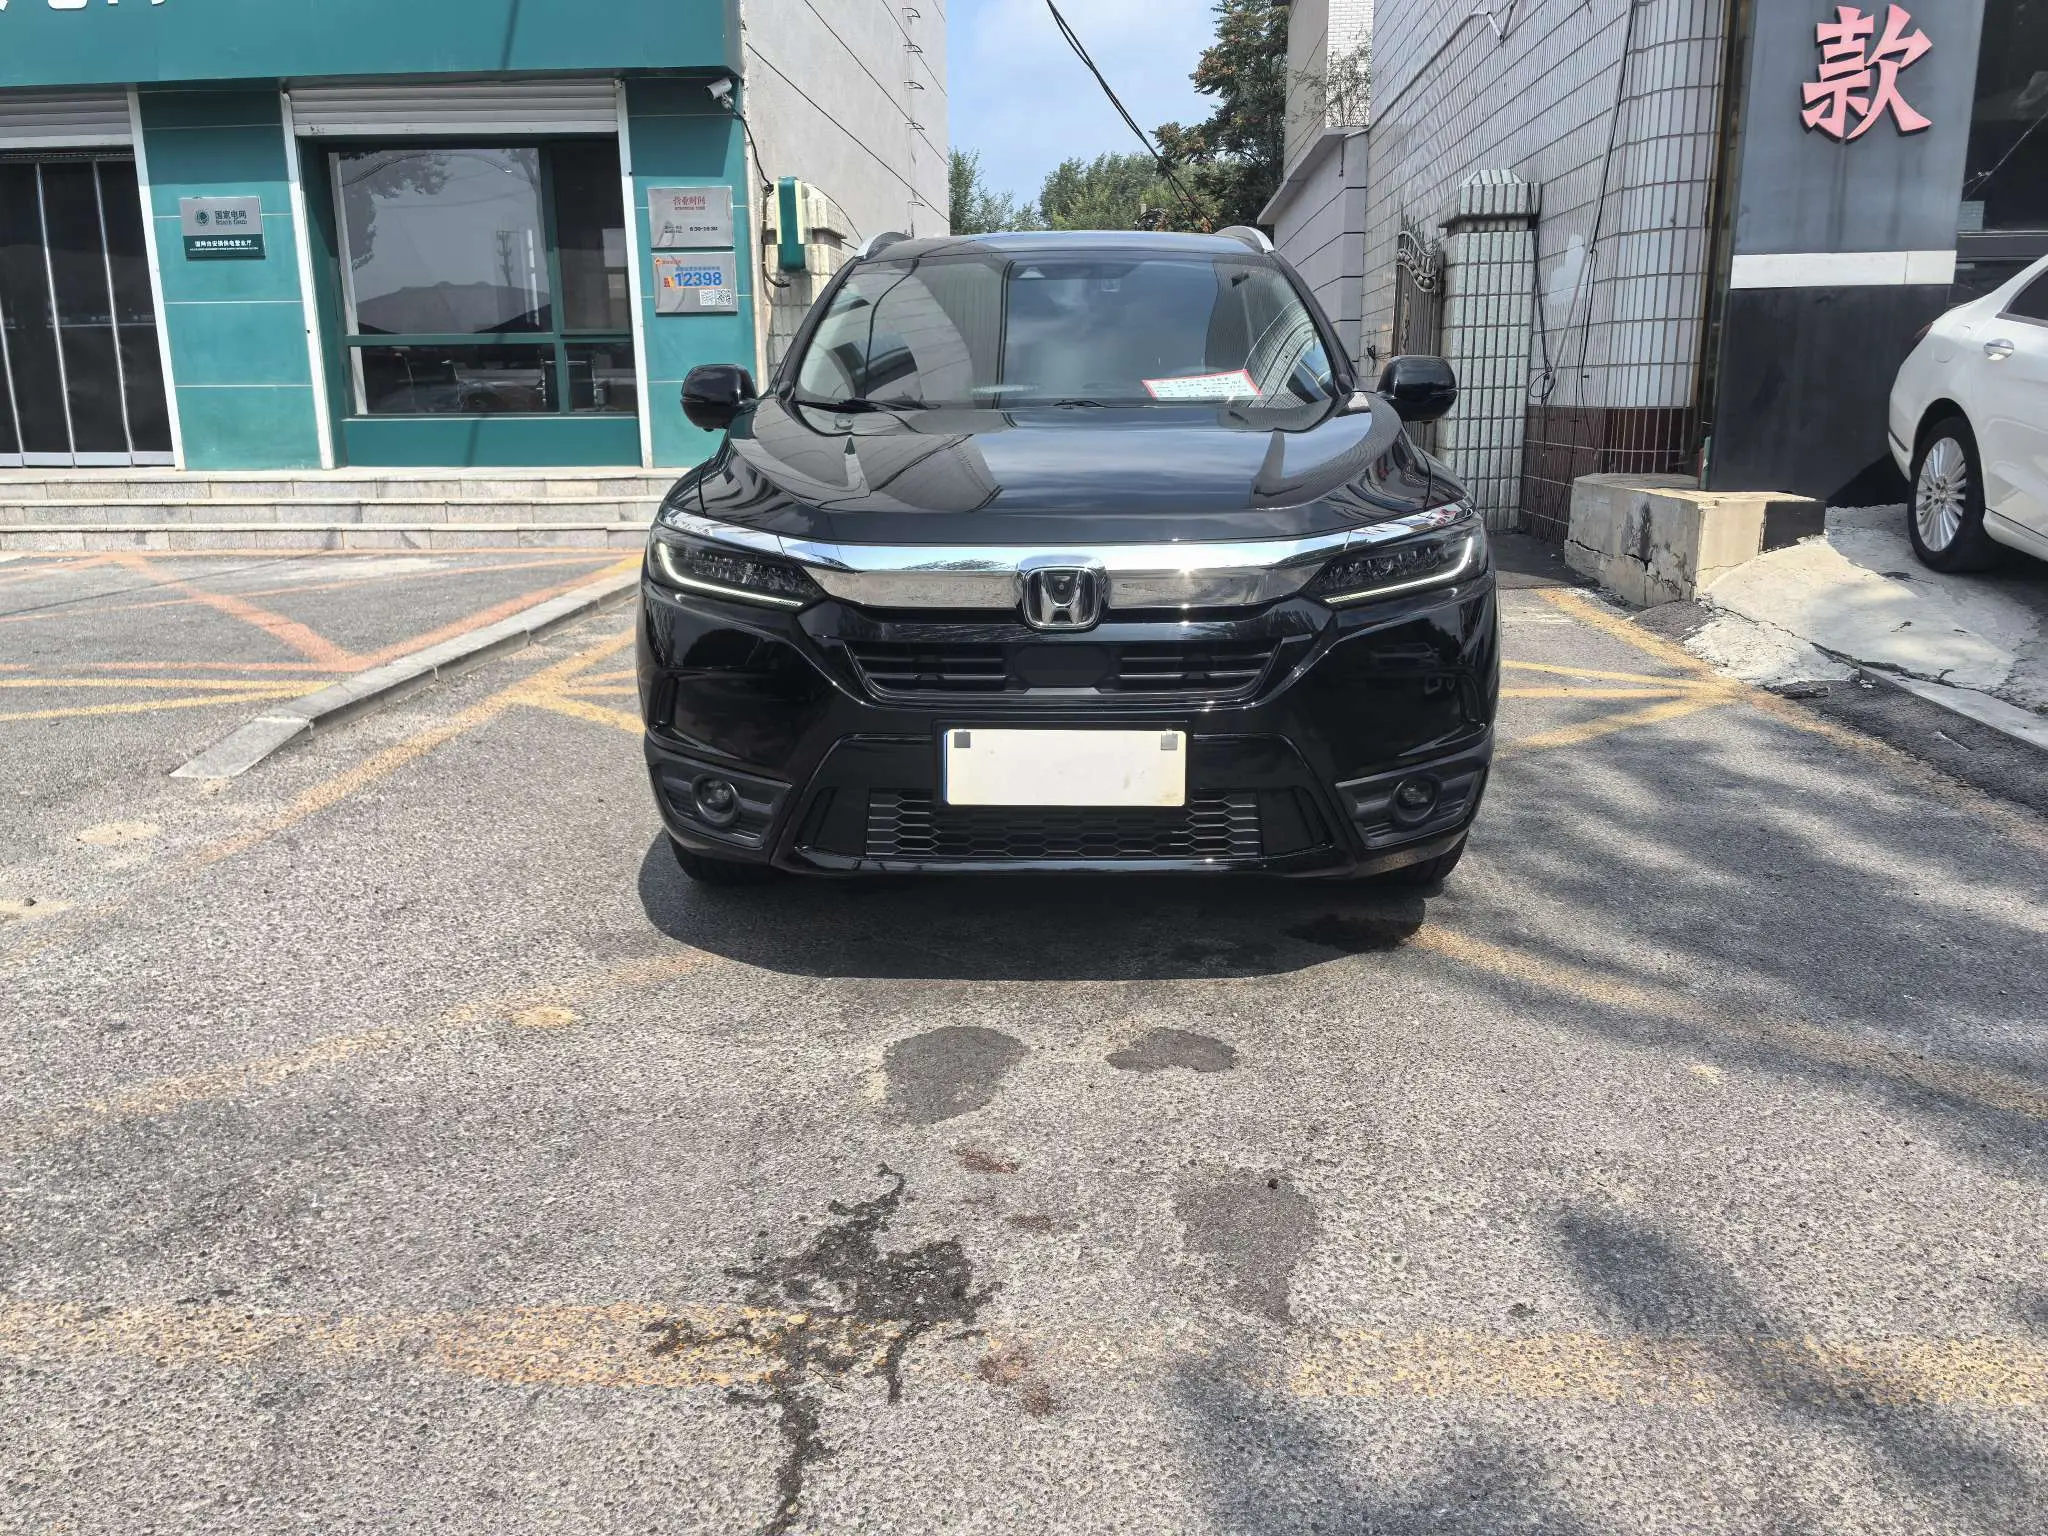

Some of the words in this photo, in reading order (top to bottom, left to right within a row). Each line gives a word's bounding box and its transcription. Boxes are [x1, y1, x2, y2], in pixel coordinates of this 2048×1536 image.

[1801, 3, 1933, 140] 款
[215, 210, 247, 219] 国家电网
[675, 272, 722, 287] 12398
